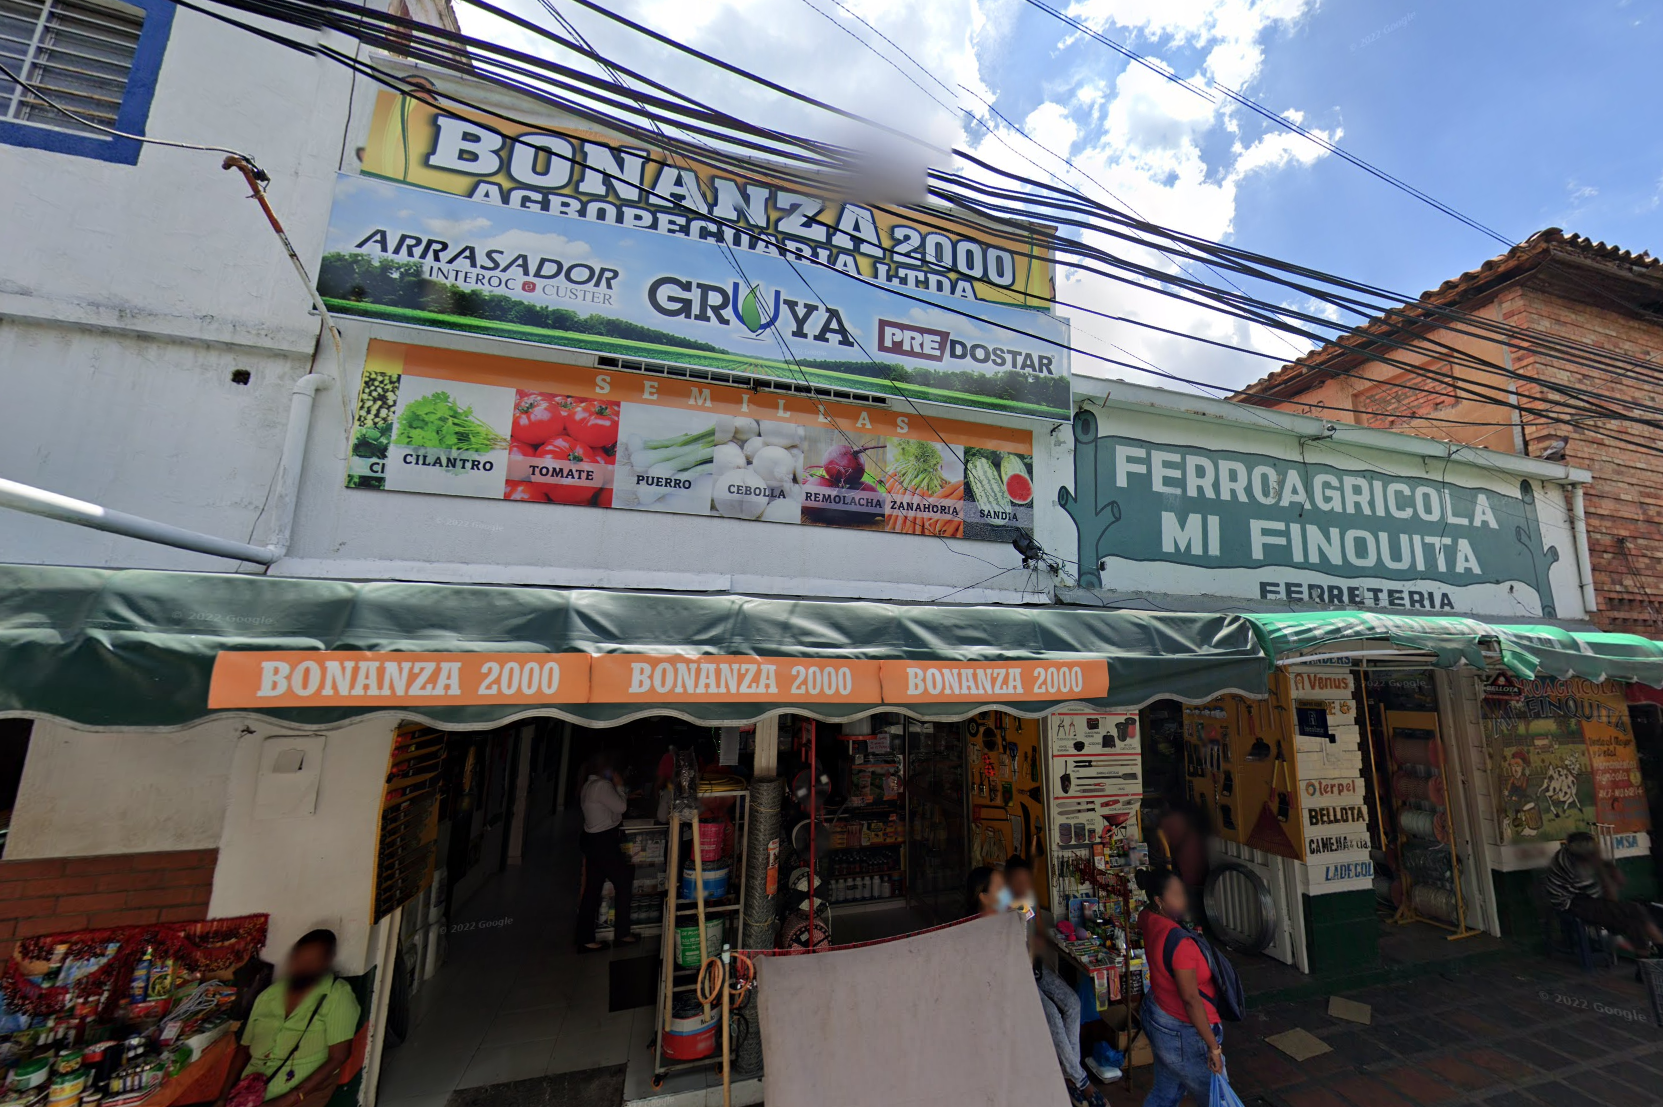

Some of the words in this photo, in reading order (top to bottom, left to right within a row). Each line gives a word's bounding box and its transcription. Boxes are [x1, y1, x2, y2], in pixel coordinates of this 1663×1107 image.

[427, 113, 887, 260] BONANZA
[891, 225, 1015, 288] 2000
[356, 229, 620, 290] ARRASADOR
[429, 265, 517, 291] INTEROC
[542, 283, 614, 306] CUSTER
[876, 262, 977, 300] LTDA
[648, 276, 855, 348] GRUYA
[595, 375, 909, 433] SEMILLAS
[403, 453, 494, 472] CILANTRO
[529, 464, 595, 481] TOMATE
[635, 474, 692, 490] PUERRO
[727, 484, 786, 499] CEBOLLA
[1115, 445, 1499, 530] FERROAGRICOLA
[804, 491, 883, 508] REMOLACHA
[890, 500, 959, 516] ZANAHORIA
[979, 509, 1019, 522] SANDIA
[1161, 511, 1221, 557] MI
[1259, 582, 1455, 610] FERRETERIA
[256, 660, 462, 697] BONANZA
[478, 661, 560, 695] 2000
[628, 662, 778, 695] BONANZA
[791, 665, 852, 695] 2000
[906, 667, 1024, 695] BONANZA
[1033, 666, 1083, 694] 2000
[1307, 673, 1349, 691] Venus
[1487, 685, 1519, 693] BELLOTA
[1525, 695, 1628, 735] FINQUITA
[1308, 806, 1366, 826] BELLOTA
[1325, 861, 1374, 881] LADECOL
